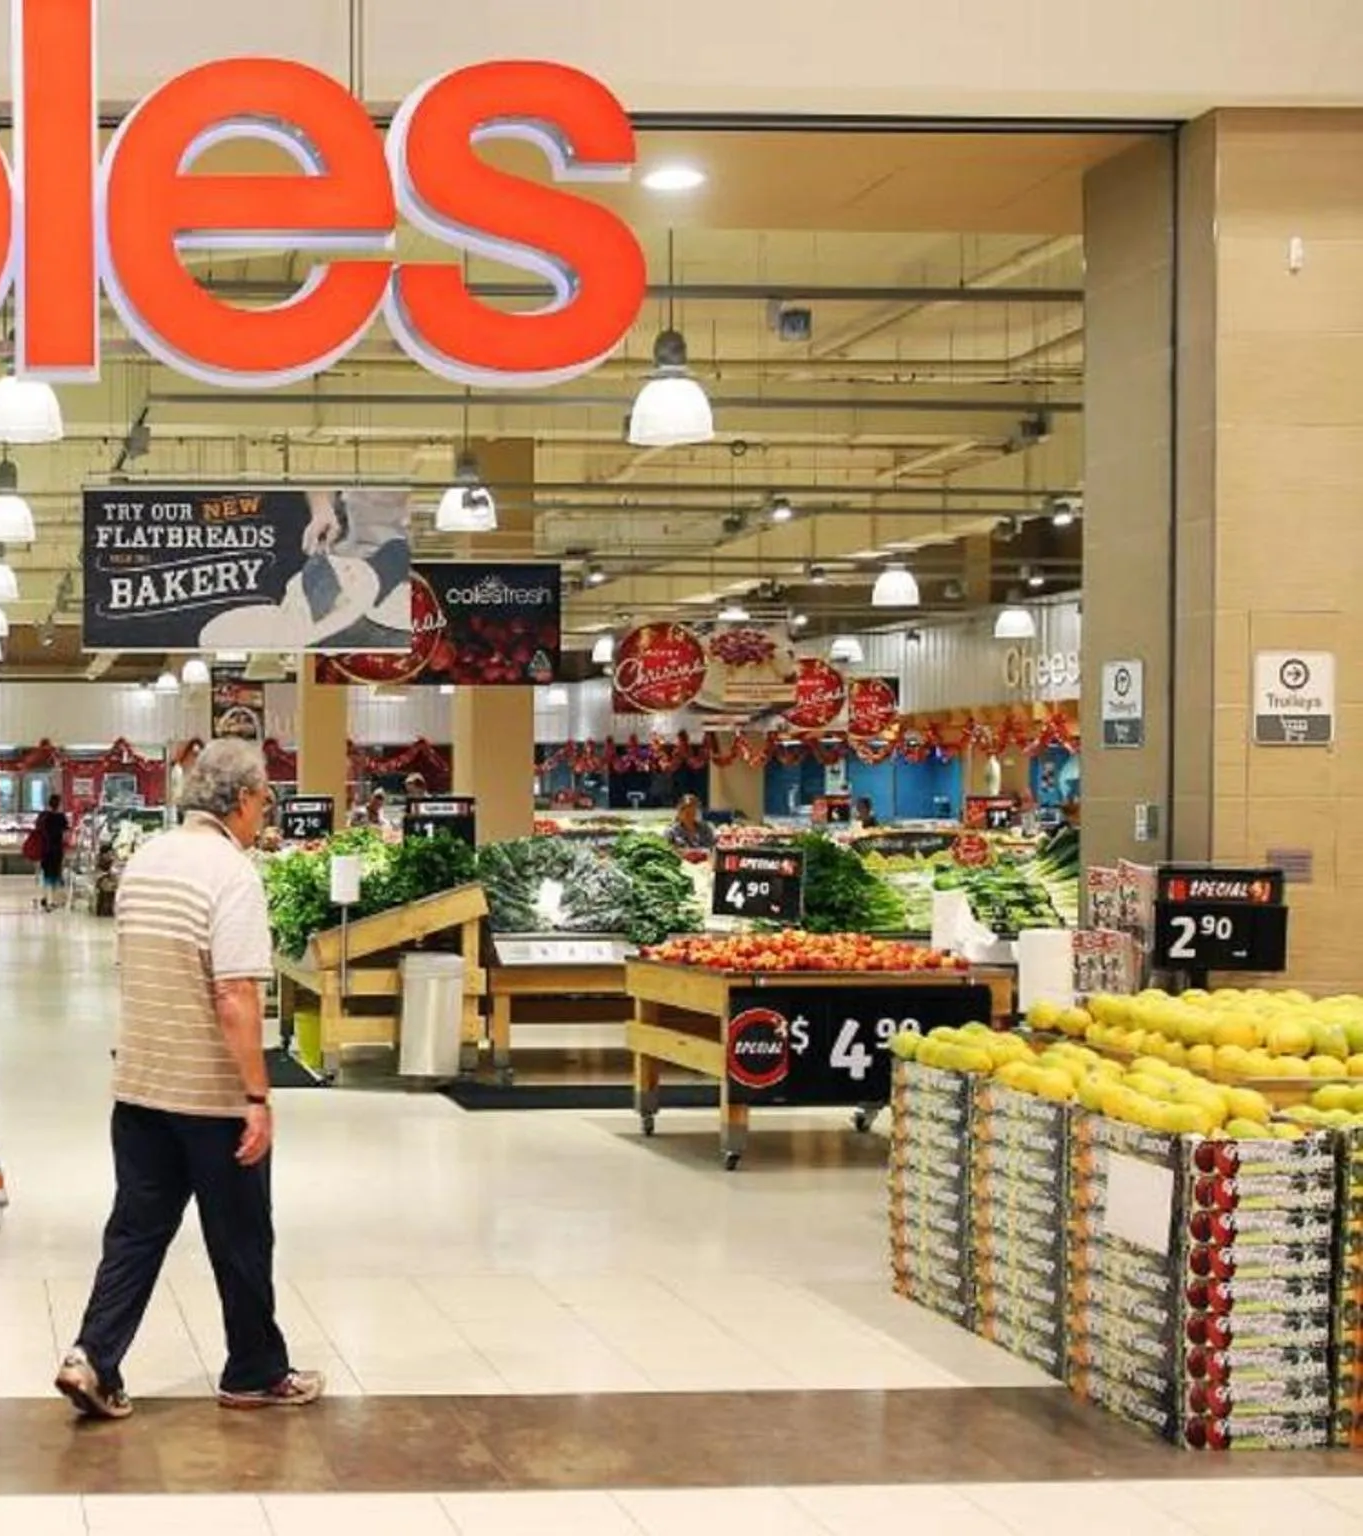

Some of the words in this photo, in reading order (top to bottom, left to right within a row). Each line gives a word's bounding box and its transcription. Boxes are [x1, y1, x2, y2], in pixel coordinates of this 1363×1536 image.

[103, 503, 145, 521] TRY
[151, 503, 193, 521] OUR
[203, 498, 260, 522] NEW
[95, 525, 276, 548] FLATBREADS
[109, 559, 263, 609] BAKERY
[1265, 694, 1323, 711] Trolleys
[1189, 880, 1249, 898] SPECIAL
